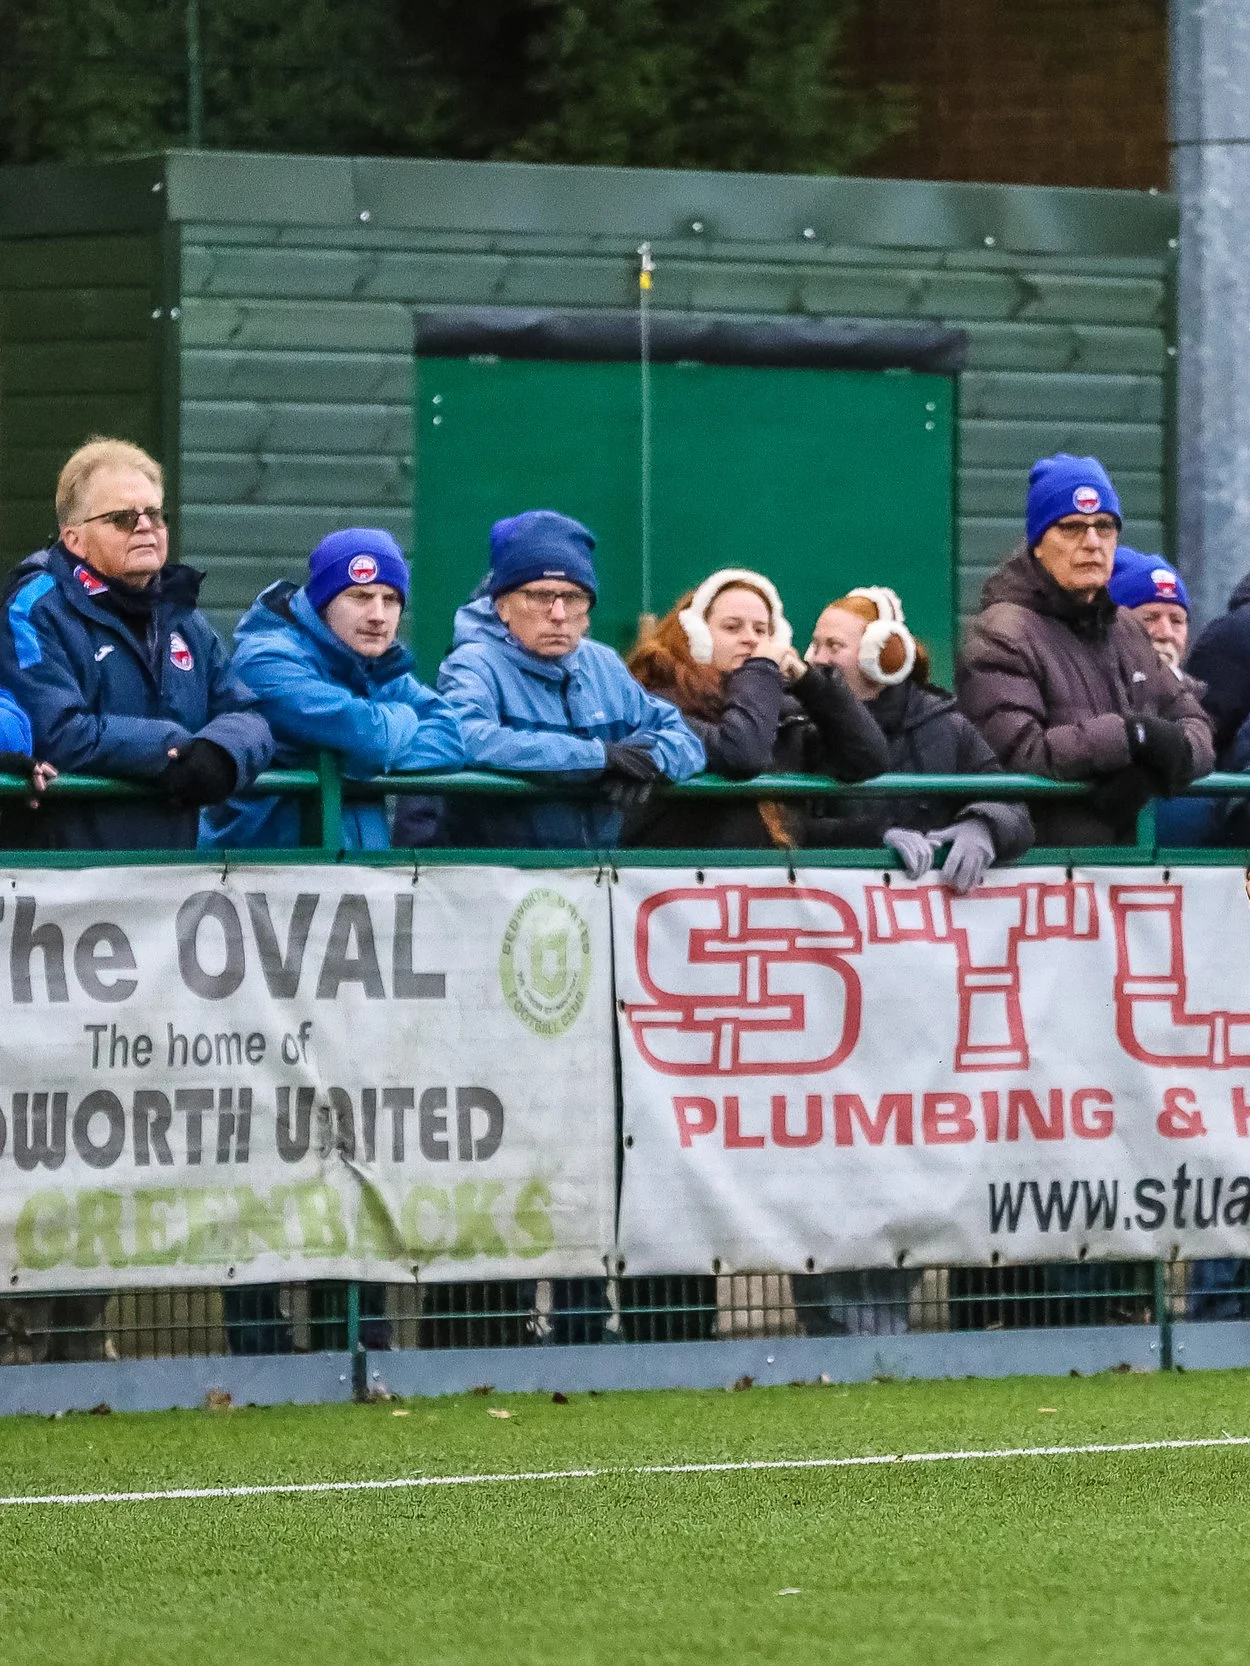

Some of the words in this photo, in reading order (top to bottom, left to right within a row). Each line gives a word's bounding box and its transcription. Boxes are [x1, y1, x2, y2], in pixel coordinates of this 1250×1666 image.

[0, 894, 138, 1003] he
[176, 890, 446, 1001] OVAL
[84, 1023, 152, 1070] The
[167, 1023, 266, 1067] home
[281, 1021, 312, 1065] of
[0, 1086, 253, 1171] WORTH
[275, 1086, 504, 1164] UNITED
[672, 1087, 1115, 1150] PLUMBING
[1157, 1087, 1208, 1140] &
